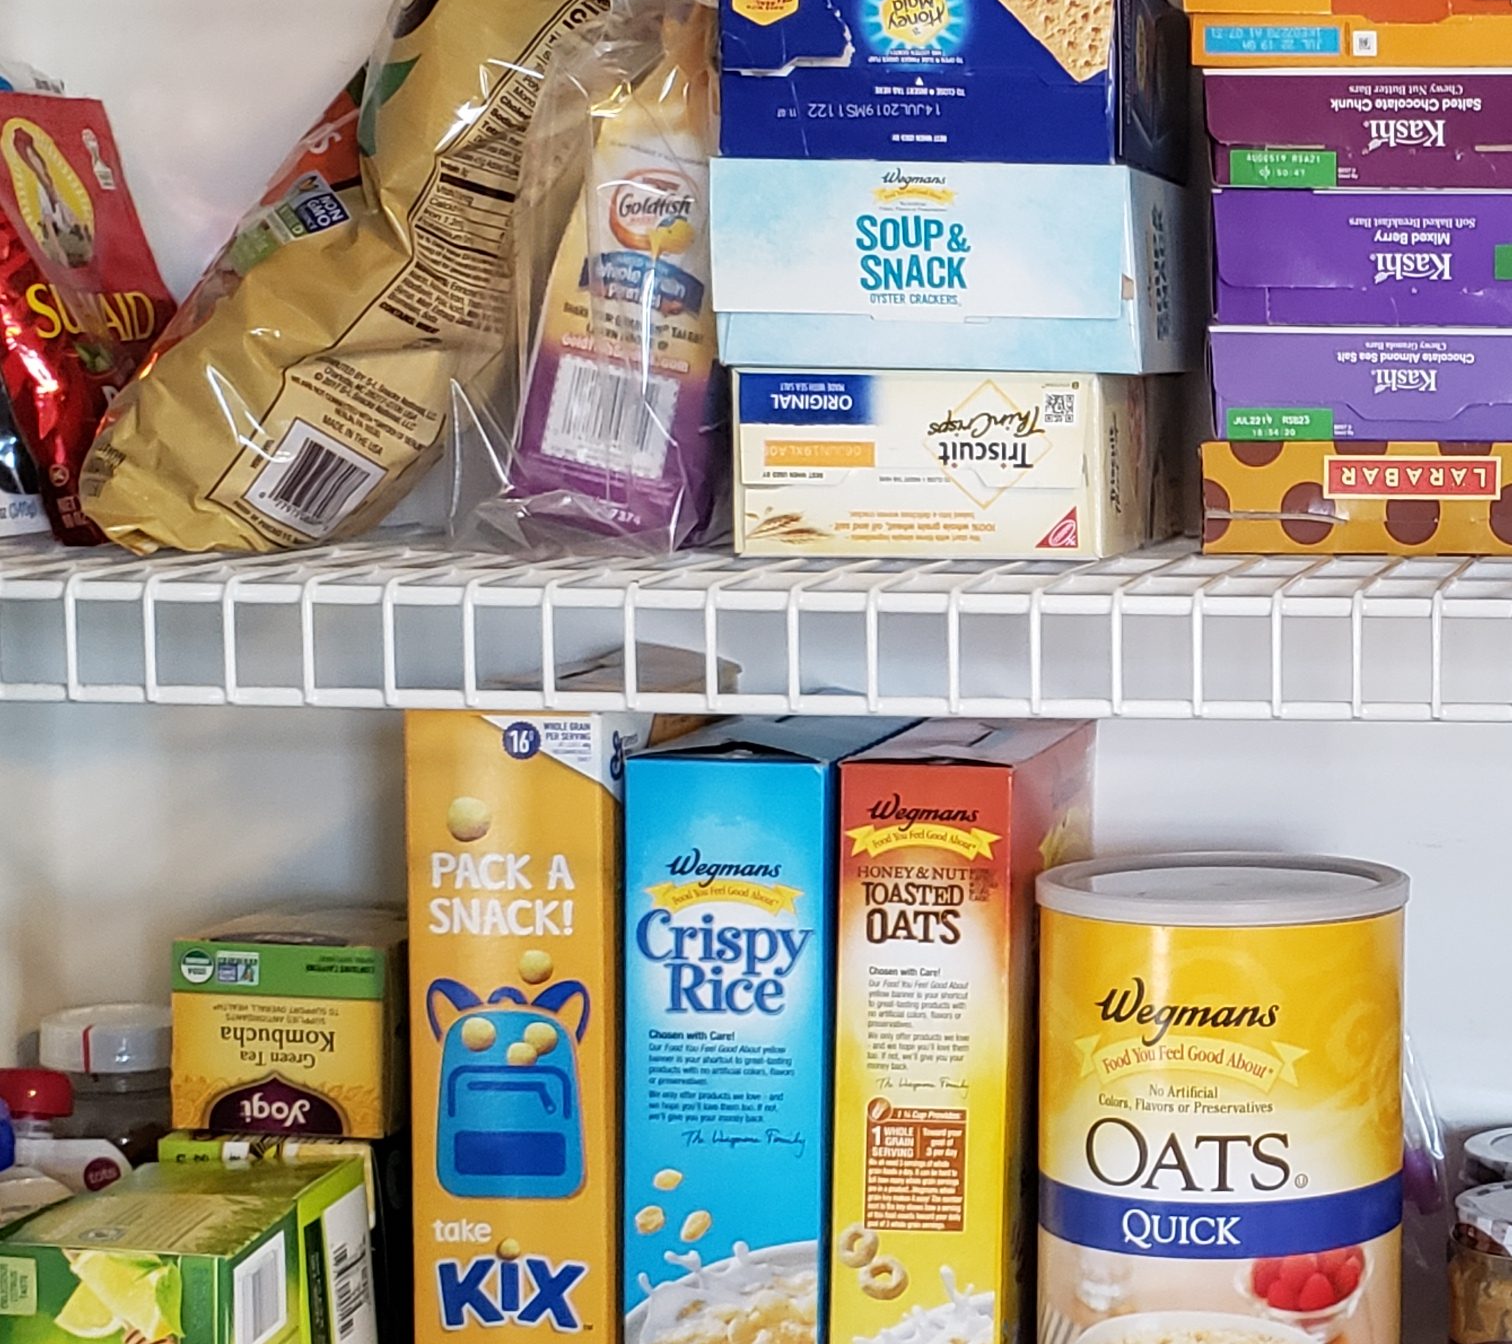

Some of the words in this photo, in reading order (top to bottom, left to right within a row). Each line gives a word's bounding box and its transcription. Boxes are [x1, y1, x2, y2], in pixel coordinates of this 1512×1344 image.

[1330, 99, 1373, 112] Chunk
[1374, 98, 1440, 111] Chocolate
[1445, 98, 1482, 111] Salted
[1368, 119, 1446, 149] Kashi
[881, 167, 947, 190] Wegmans
[618, 190, 691, 217] Goldfish
[856, 214, 944, 251] SOUP
[947, 223, 972, 253] &
[1374, 231, 1411, 246] Berry
[1413, 232, 1451, 245] Mixed
[860, 254, 967, 291] SNACK
[1374, 253, 1453, 284] Kashi
[870, 293, 906, 305] OYSTER
[909, 294, 959, 306] CRACKERS
[1374, 369, 1438, 395] Kashi
[771, 394, 853, 412] ORIGINAL
[938, 440, 1034, 469] Triscuit
[1341, 467, 1487, 488] LARABAR
[867, 793, 980, 832] Wegmans
[432, 851, 533, 891] PACK
[547, 853, 576, 891] A
[666, 847, 782, 888] Wegmans
[857, 866, 915, 881] HONEY
[916, 867, 928, 880] &
[932, 867, 968, 881] NUT
[861, 882, 964, 907] TOASTED
[429, 898, 576, 937] SNACK!
[866, 908, 961, 945] OATS
[635, 908, 814, 977] Crispy
[664, 962, 786, 1016] Rice
[1094, 976, 1281, 1048] Wegmans
[220, 1026, 336, 1053] Kombucha
[240, 1050, 266, 1067] Tea
[270, 1051, 317, 1068] Green
[1103, 1055, 1132, 1074] Food
[1132, 1047, 1156, 1062] You
[1158, 1044, 1185, 1061] Feel
[1187, 1045, 1225, 1064] Good
[1226, 1052, 1268, 1078] About
[240, 1093, 311, 1127] yogi
[1085, 1117, 1291, 1193] OATS
[432, 1219, 493, 1244] take
[1122, 1208, 1242, 1249] QUICK
